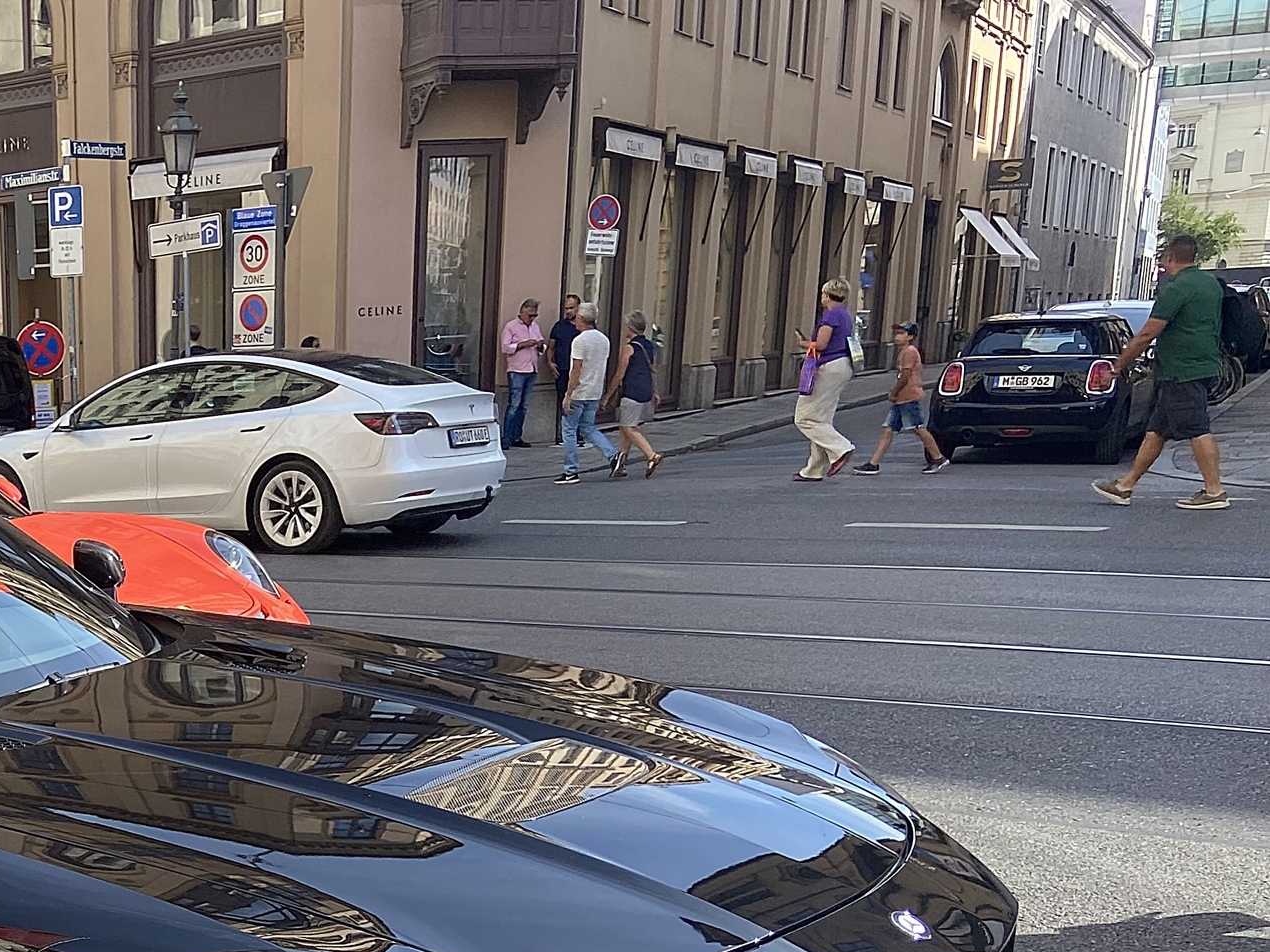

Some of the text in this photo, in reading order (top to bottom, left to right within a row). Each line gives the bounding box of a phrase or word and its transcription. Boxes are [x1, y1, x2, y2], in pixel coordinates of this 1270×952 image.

[73, 142, 125, 158] Falckenbergstr.
[5, 170, 60, 189] Maximilianstr.
[181, 173, 221, 188] ELINE
[237, 210, 272, 220] Blaue Zone
[174, 230, 200, 244] Parkhaus
[245, 244, 263, 263] 30
[243, 275, 265, 285] ZONE
[358, 305, 403, 317] CELINE
[242, 333, 264, 344] ZONE
[1002, 376, 1050, 386] M GB 962
